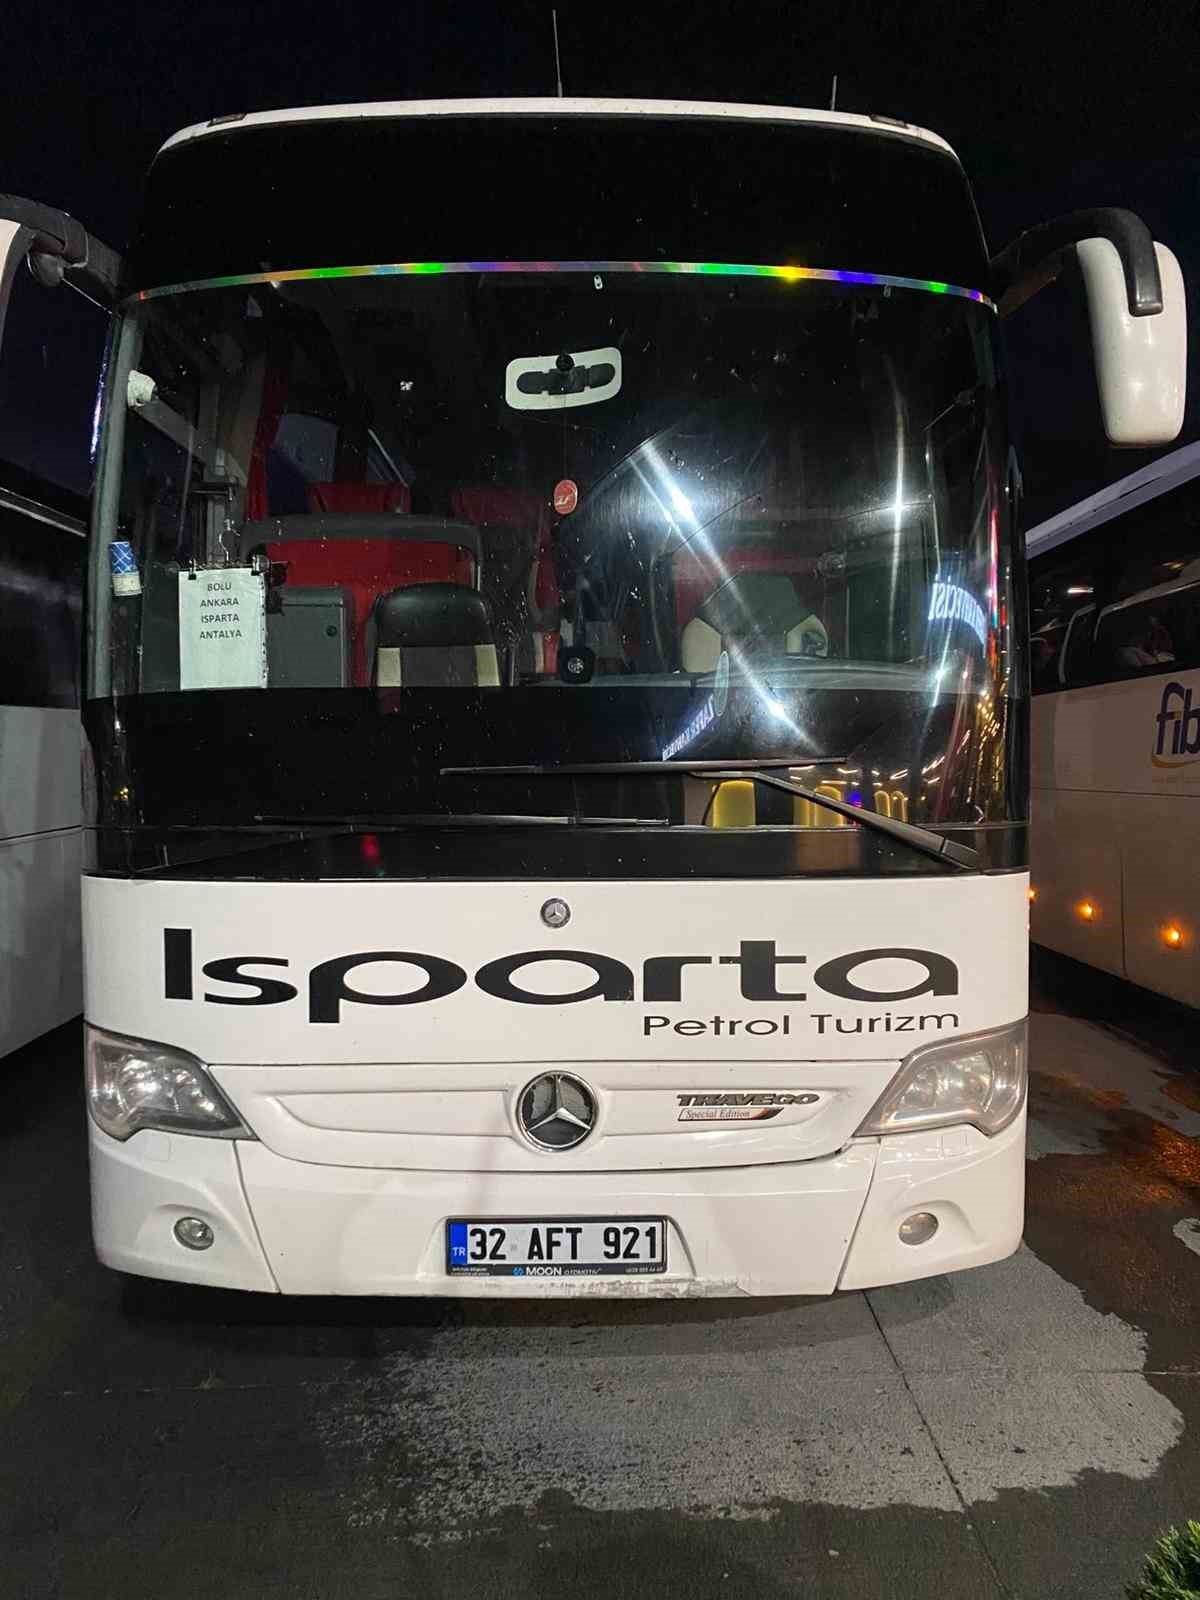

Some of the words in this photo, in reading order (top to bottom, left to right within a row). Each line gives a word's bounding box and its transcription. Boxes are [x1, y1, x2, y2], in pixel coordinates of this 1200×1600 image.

[208, 582, 231, 591] BOLU
[200, 598, 239, 607] ANKARA
[201, 613, 240, 623] ISPARTA
[200, 630, 242, 639] ANTALYA
[164, 928, 959, 1023] Isparta
[643, 1015, 790, 1036] Petrol
[811, 1012, 959, 1034] Turizm
[677, 1093, 819, 1106] TRAVEGO
[686, 1107, 718, 1119] Special
[719, 1107, 750, 1117] Edition
[469, 1227, 507, 1260] 32
[527, 1227, 583, 1260] AFT
[603, 1226, 657, 1259] 921
[452, 1246, 466, 1257] TR
[525, 1267, 562, 1276] MOON
